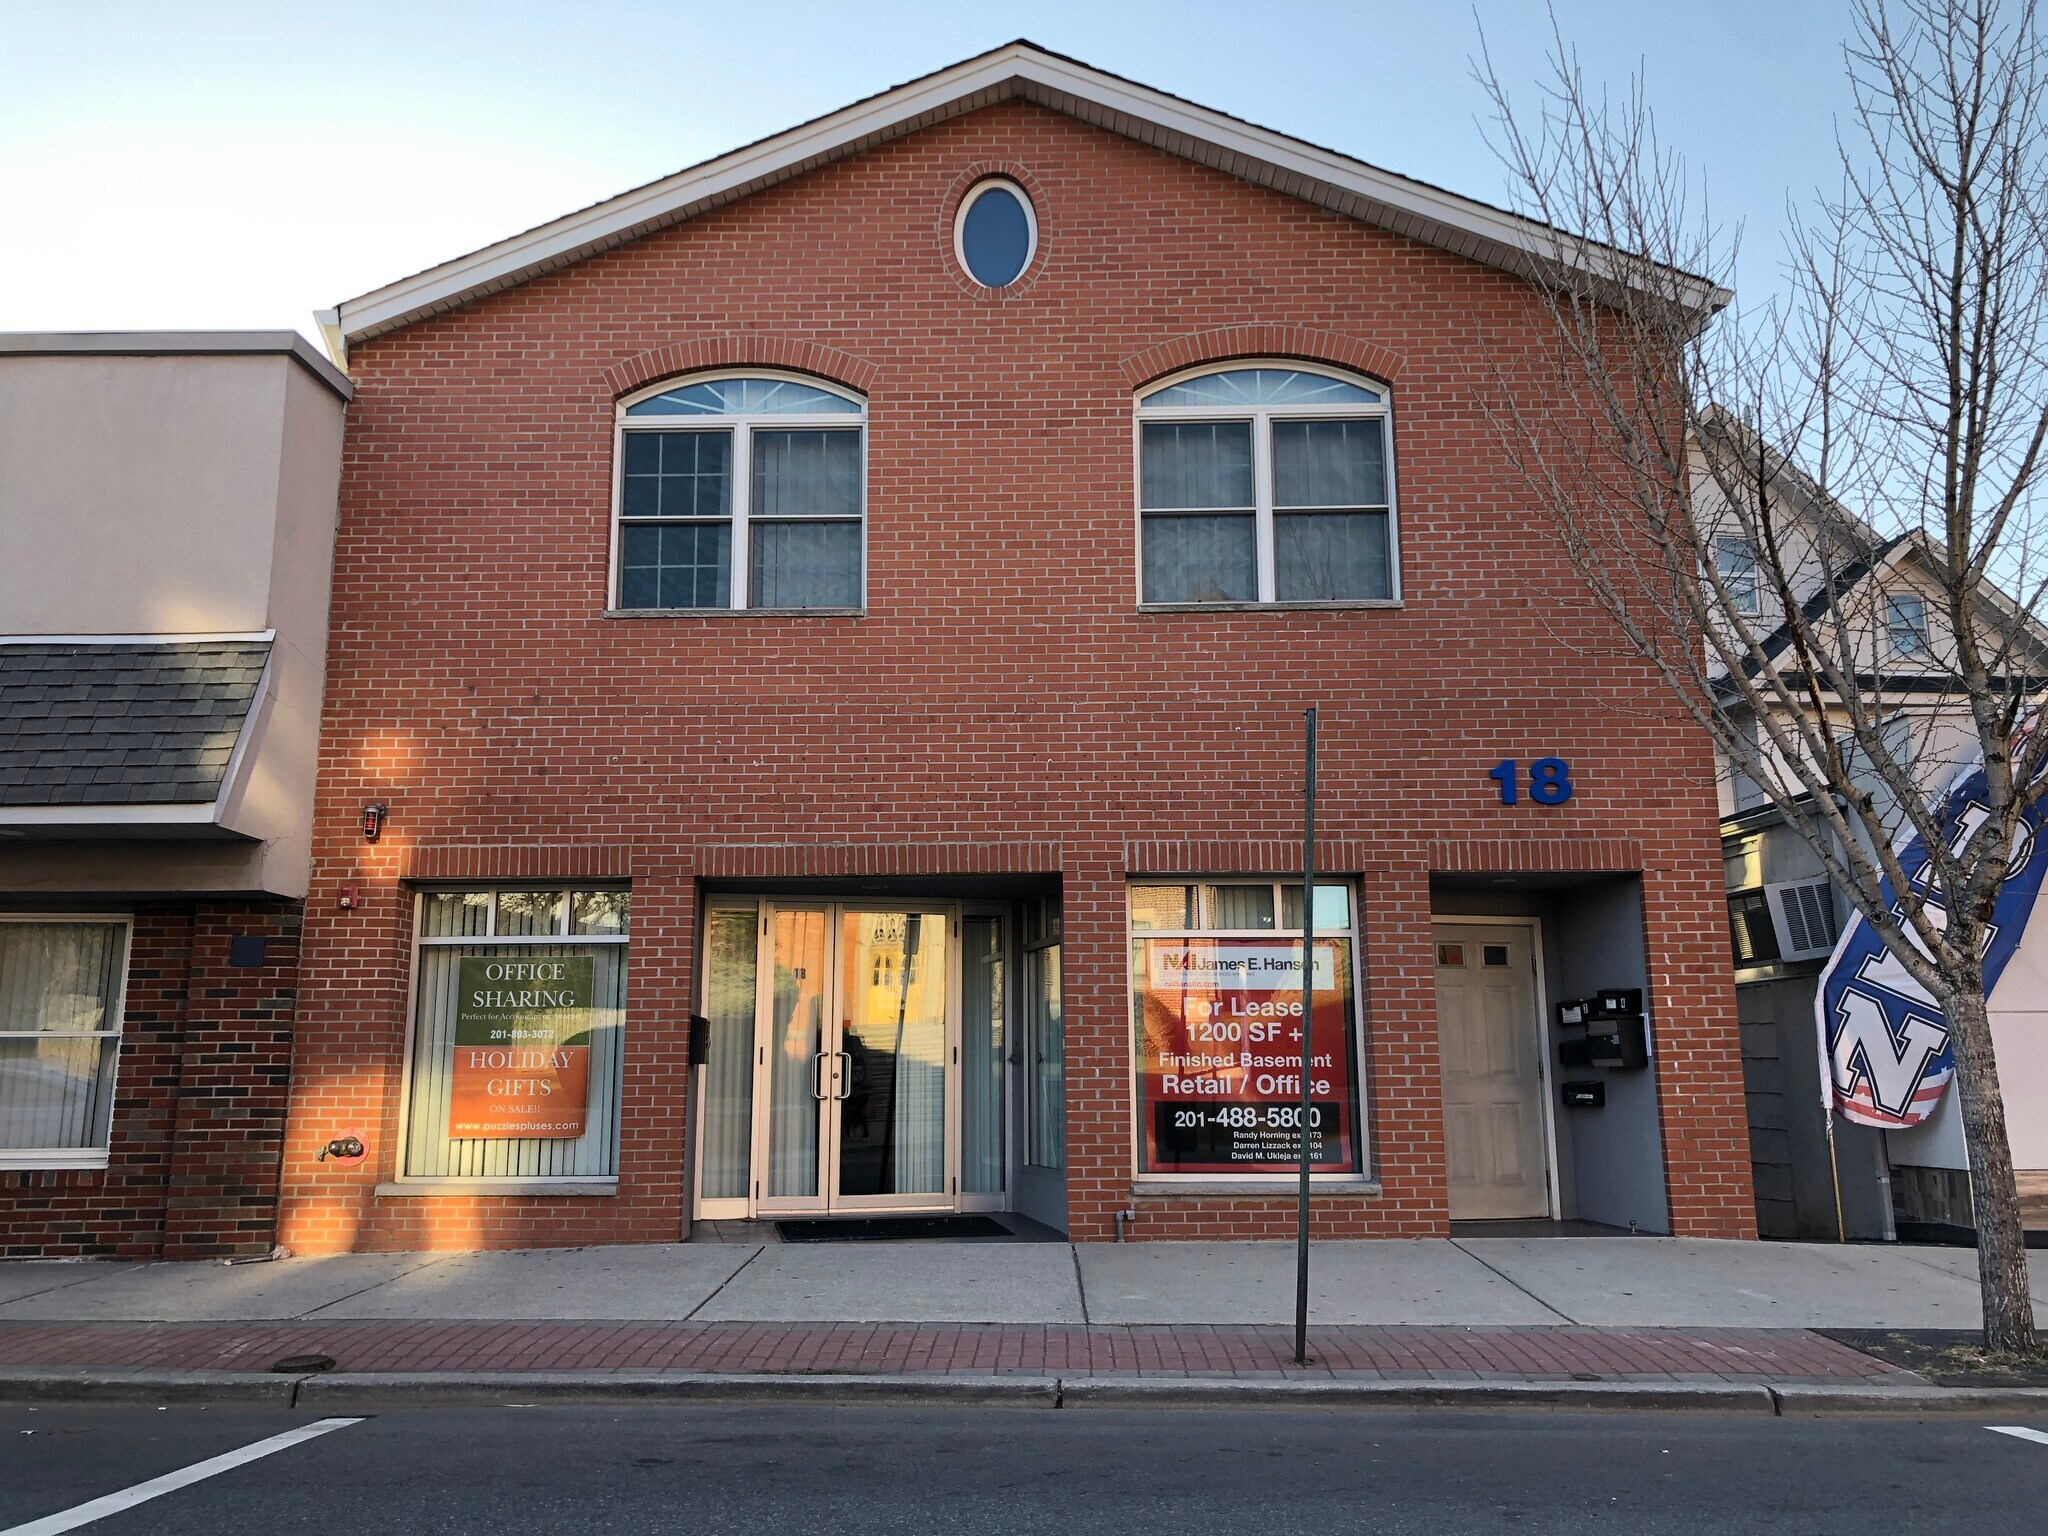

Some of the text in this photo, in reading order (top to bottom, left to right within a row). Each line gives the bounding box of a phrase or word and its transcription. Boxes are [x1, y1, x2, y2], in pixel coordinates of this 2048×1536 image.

[1489, 757, 1573, 806] 18
[1163, 950, 1320, 971] NAI James E. Hansn
[485, 963, 566, 981] OFFICE
[794, 967, 806, 979] 18
[472, 990, 576, 1008] SHARING
[1183, 997, 1303, 1017] For Lease
[490, 1029, 554, 1039] 201-803-3072
[1186, 1022, 1242, 1042] 1200
[1248, 1021, 1282, 1042] SF
[469, 1051, 574, 1069] HOLIDAY
[1159, 1052, 1333, 1068] Finished Basemnt
[486, 1078, 552, 1097] GIFTS
[1162, 1074, 1232, 1095] Retail
[489, 1104, 506, 1113] ON
[1174, 1107, 1321, 1128] 201-488-5800
[455, 1120, 579, 1132] www.puzzlespluses.com
[1233, 1131, 1258, 1140] Randy
[1260, 1131, 1290, 1140] Horning
[1309, 1131, 1322, 1139] 173
[1231, 1152, 1254, 1160] David
[1255, 1152, 1265, 1160] M.
[1267, 1152, 1292, 1161] Ukleja
[1309, 1152, 1323, 1160] 161
